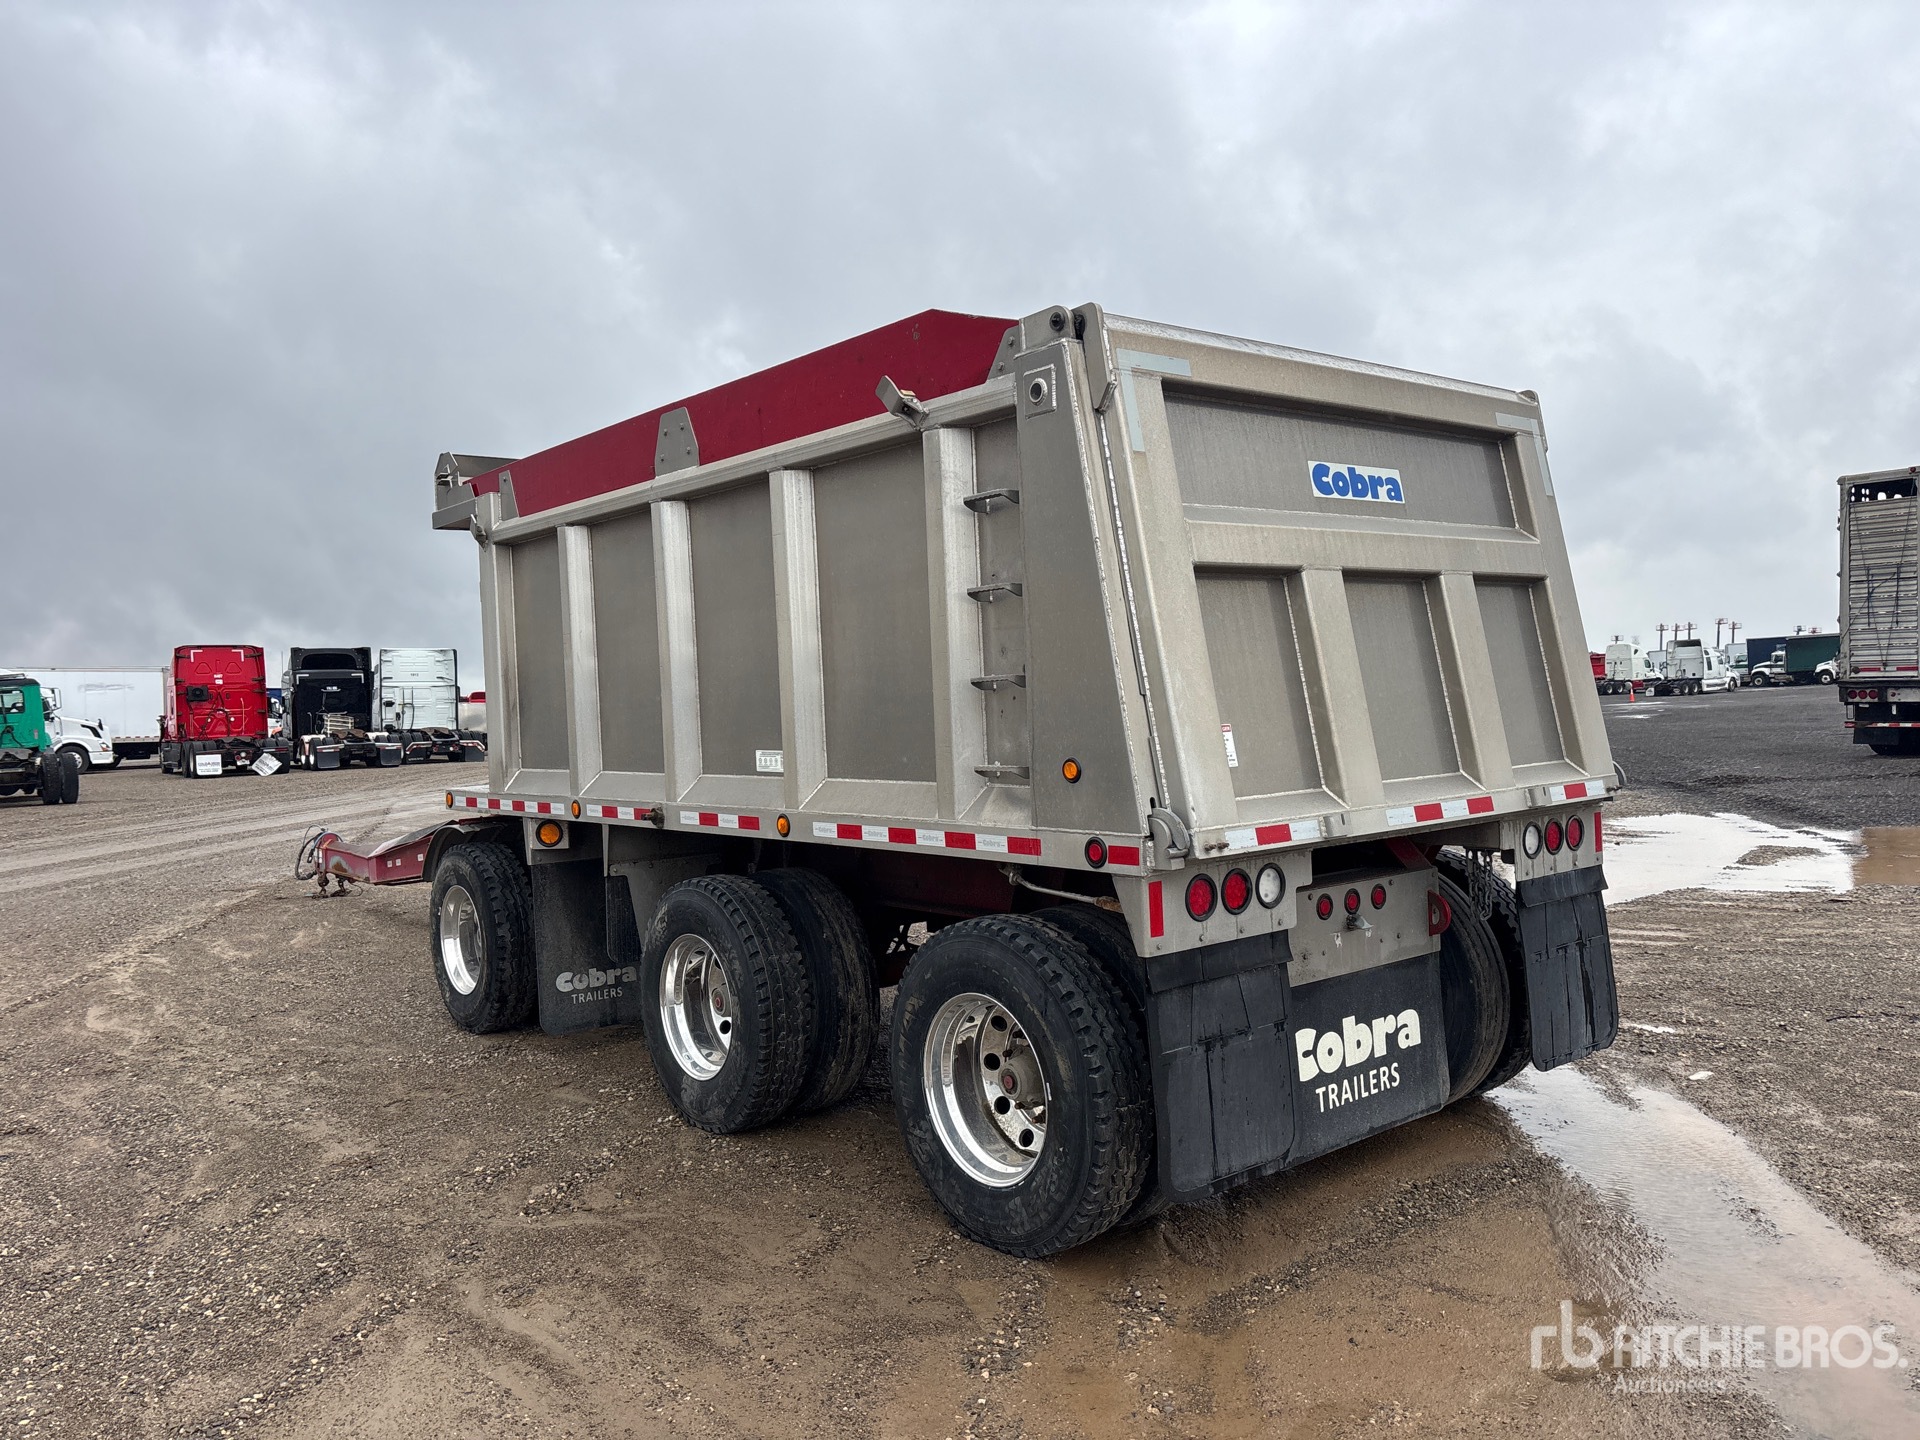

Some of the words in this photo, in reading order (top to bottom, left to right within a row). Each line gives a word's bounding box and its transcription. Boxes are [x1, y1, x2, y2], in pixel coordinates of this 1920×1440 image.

[1312, 463, 1403, 502] Cobra
[555, 966, 637, 992] Cobra
[571, 986, 623, 1004] TRAILERS
[1295, 1009, 1421, 1082] Cobra
[1315, 1062, 1400, 1113] TRAILERS
